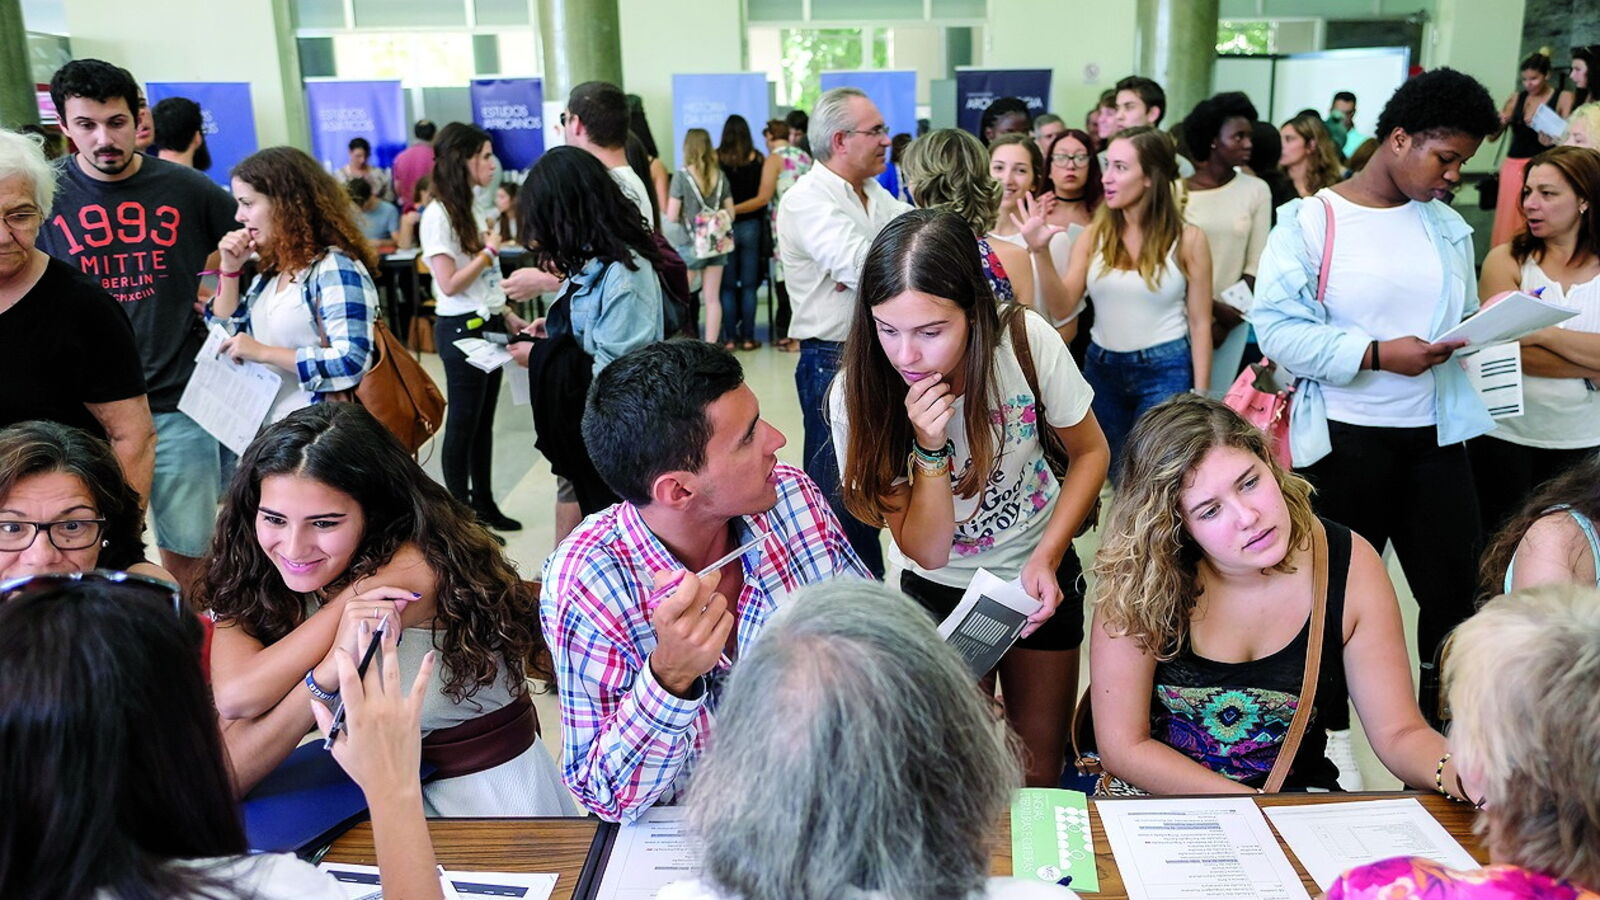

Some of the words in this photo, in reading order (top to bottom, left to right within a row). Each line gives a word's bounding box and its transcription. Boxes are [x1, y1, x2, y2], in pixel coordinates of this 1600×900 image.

[481, 104, 528, 118] ESTUDOS
[52, 201, 182, 256] 1993
[80, 250, 168, 275] MITTE
[101, 273, 154, 289] BERLIN
